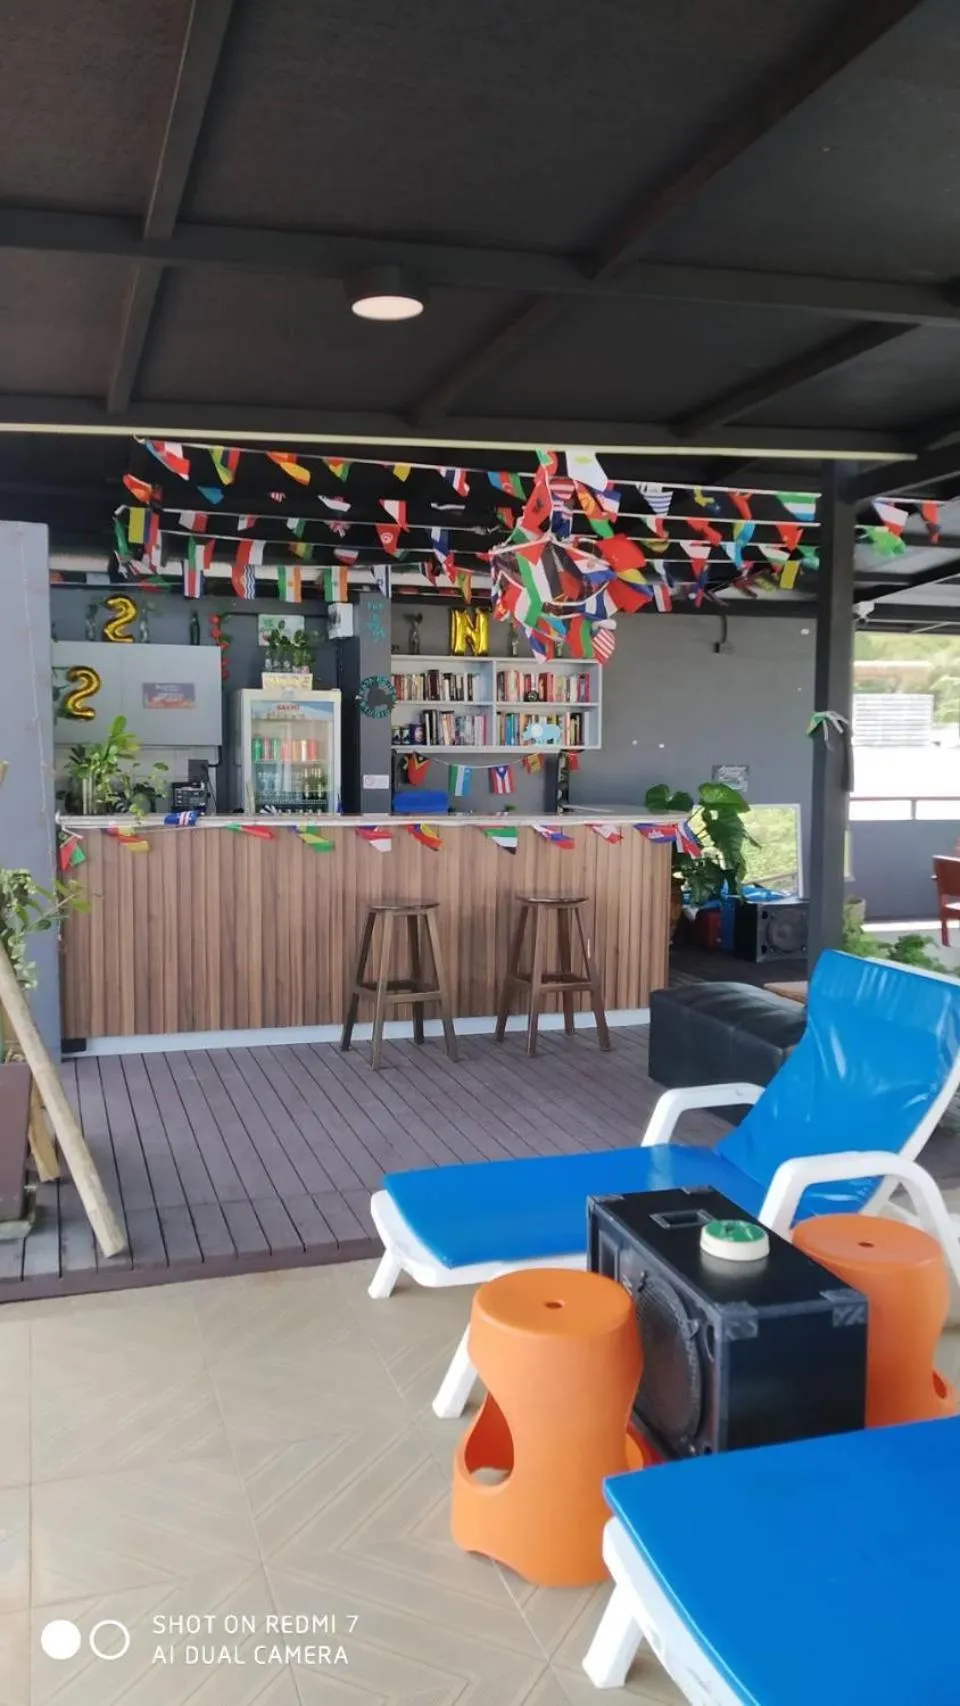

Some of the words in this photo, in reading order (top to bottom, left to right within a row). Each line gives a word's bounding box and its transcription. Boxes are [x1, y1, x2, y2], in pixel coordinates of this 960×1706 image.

[103, 594, 136, 642] 2
[449, 608, 489, 656] N
[65, 667, 101, 720] 2
